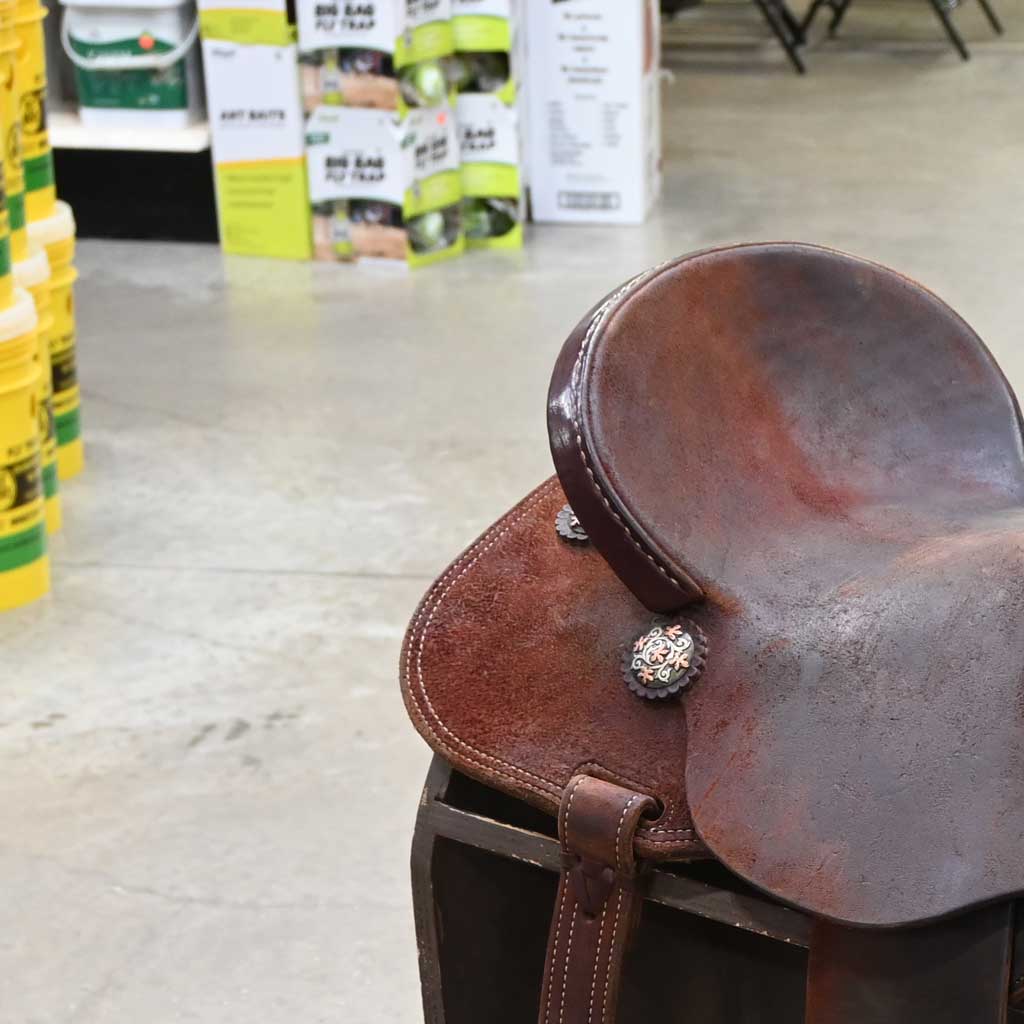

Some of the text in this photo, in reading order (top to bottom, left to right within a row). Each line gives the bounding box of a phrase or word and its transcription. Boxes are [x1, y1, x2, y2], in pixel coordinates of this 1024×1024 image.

[314, 3, 375, 17] BIG BAG
[314, 19, 376, 31] FLY TRAP
[220, 108, 286, 121] ANT BAITS
[324, 156, 386, 169] BIG BAG
[324, 172, 386, 184] FLY TRAP
